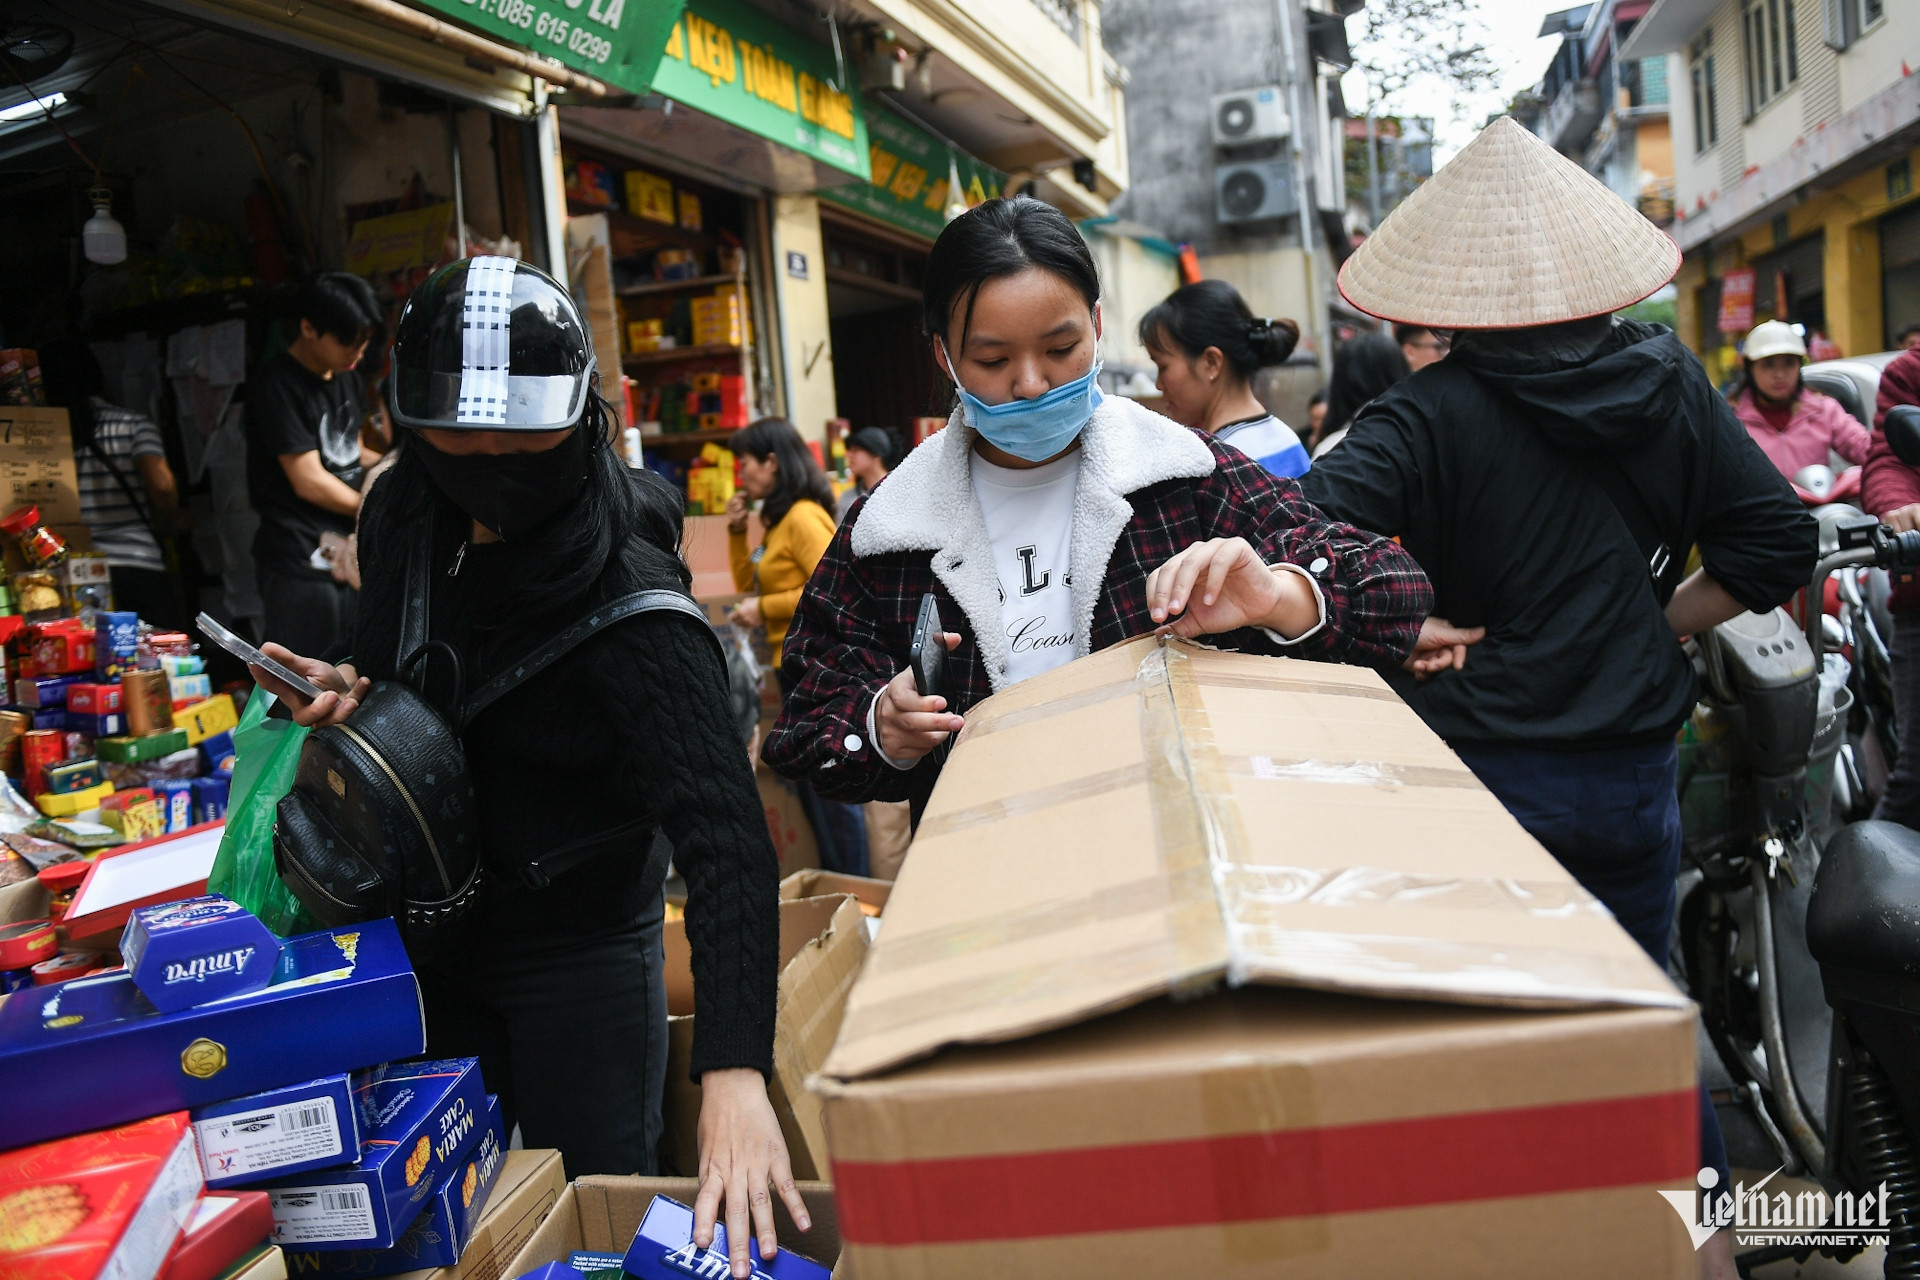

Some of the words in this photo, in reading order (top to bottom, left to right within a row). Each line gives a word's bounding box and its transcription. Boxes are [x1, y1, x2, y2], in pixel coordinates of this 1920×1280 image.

[496, 0, 537, 30] 085
[535, 12, 570, 44] 615
[567, 27, 612, 64] 0299
[685, 11, 736, 88] KẸO
[162, 947, 256, 985] Amira
[435, 1108, 474, 1163] MARIA
[440, 1097, 465, 1135] CAKE
[479, 1128, 494, 1162] CAKE
[479, 1140, 500, 1188] MARIA
